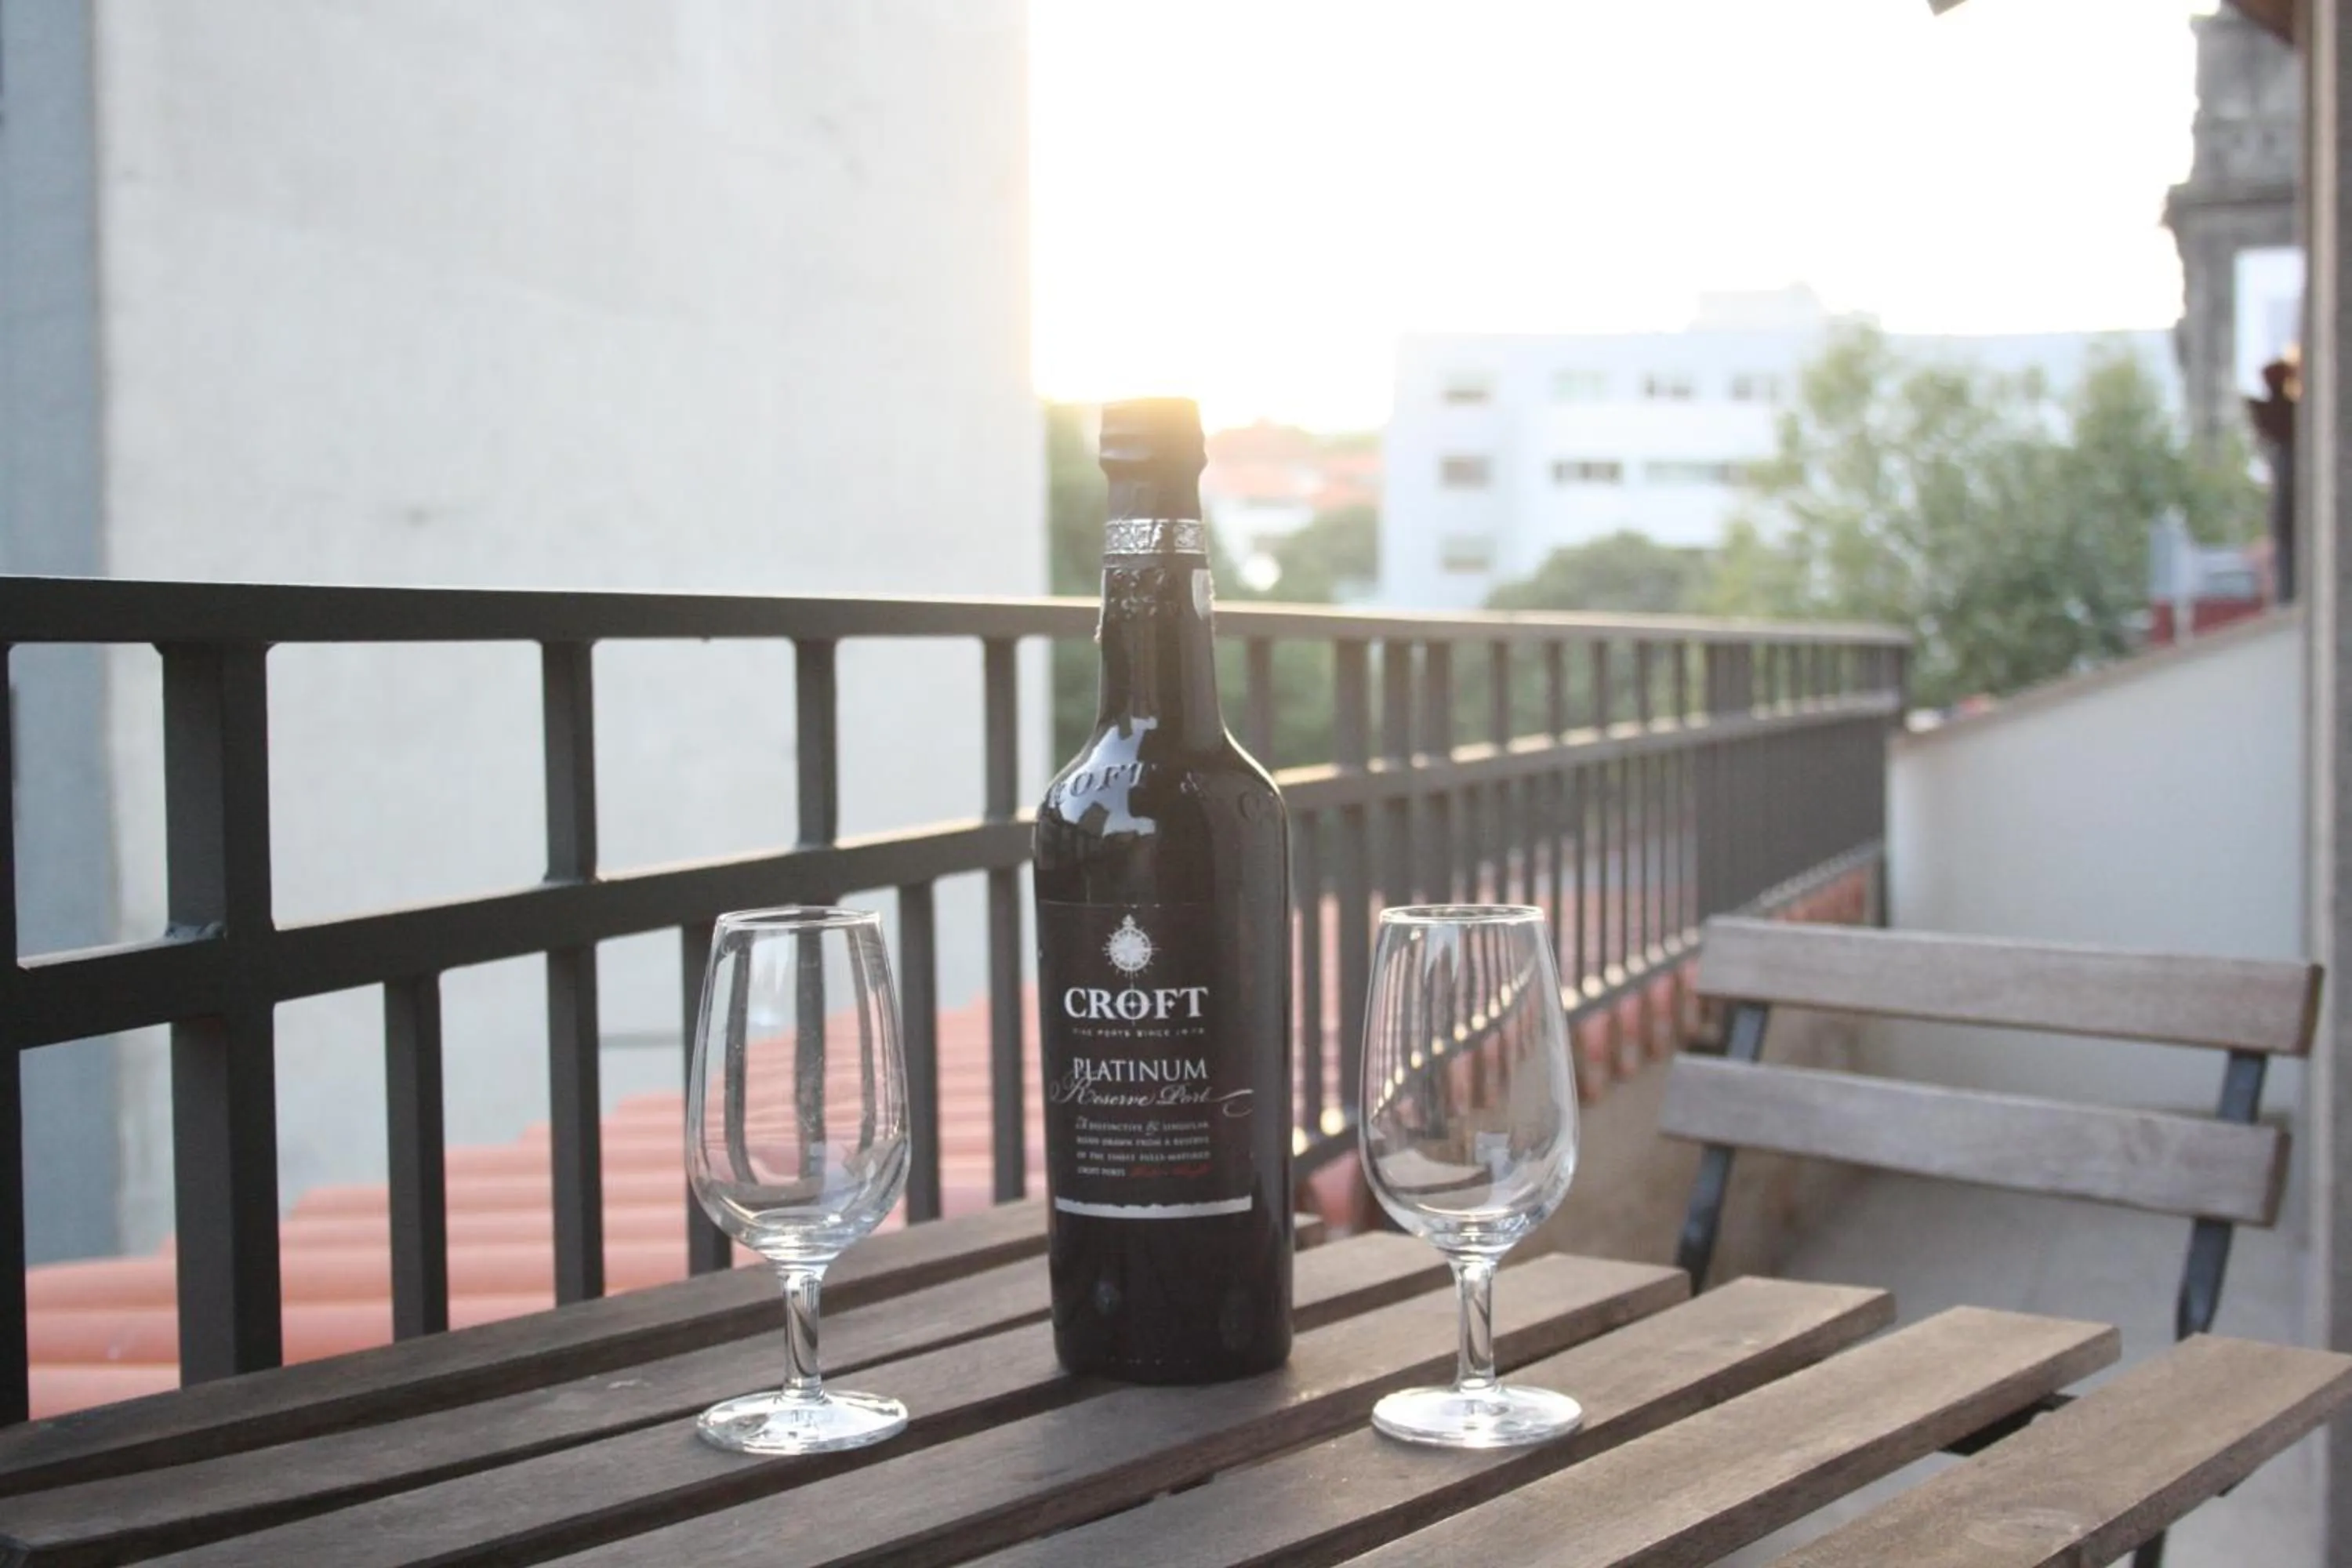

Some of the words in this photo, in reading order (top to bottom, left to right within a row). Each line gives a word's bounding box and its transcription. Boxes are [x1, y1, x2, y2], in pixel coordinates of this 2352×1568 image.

[1064, 986, 1209, 1020] CROFT
[1072, 1056, 1210, 1082] PLATINUM
[1049, 1071, 1155, 1107] Reserve
[1156, 1082, 1253, 1107] Port
